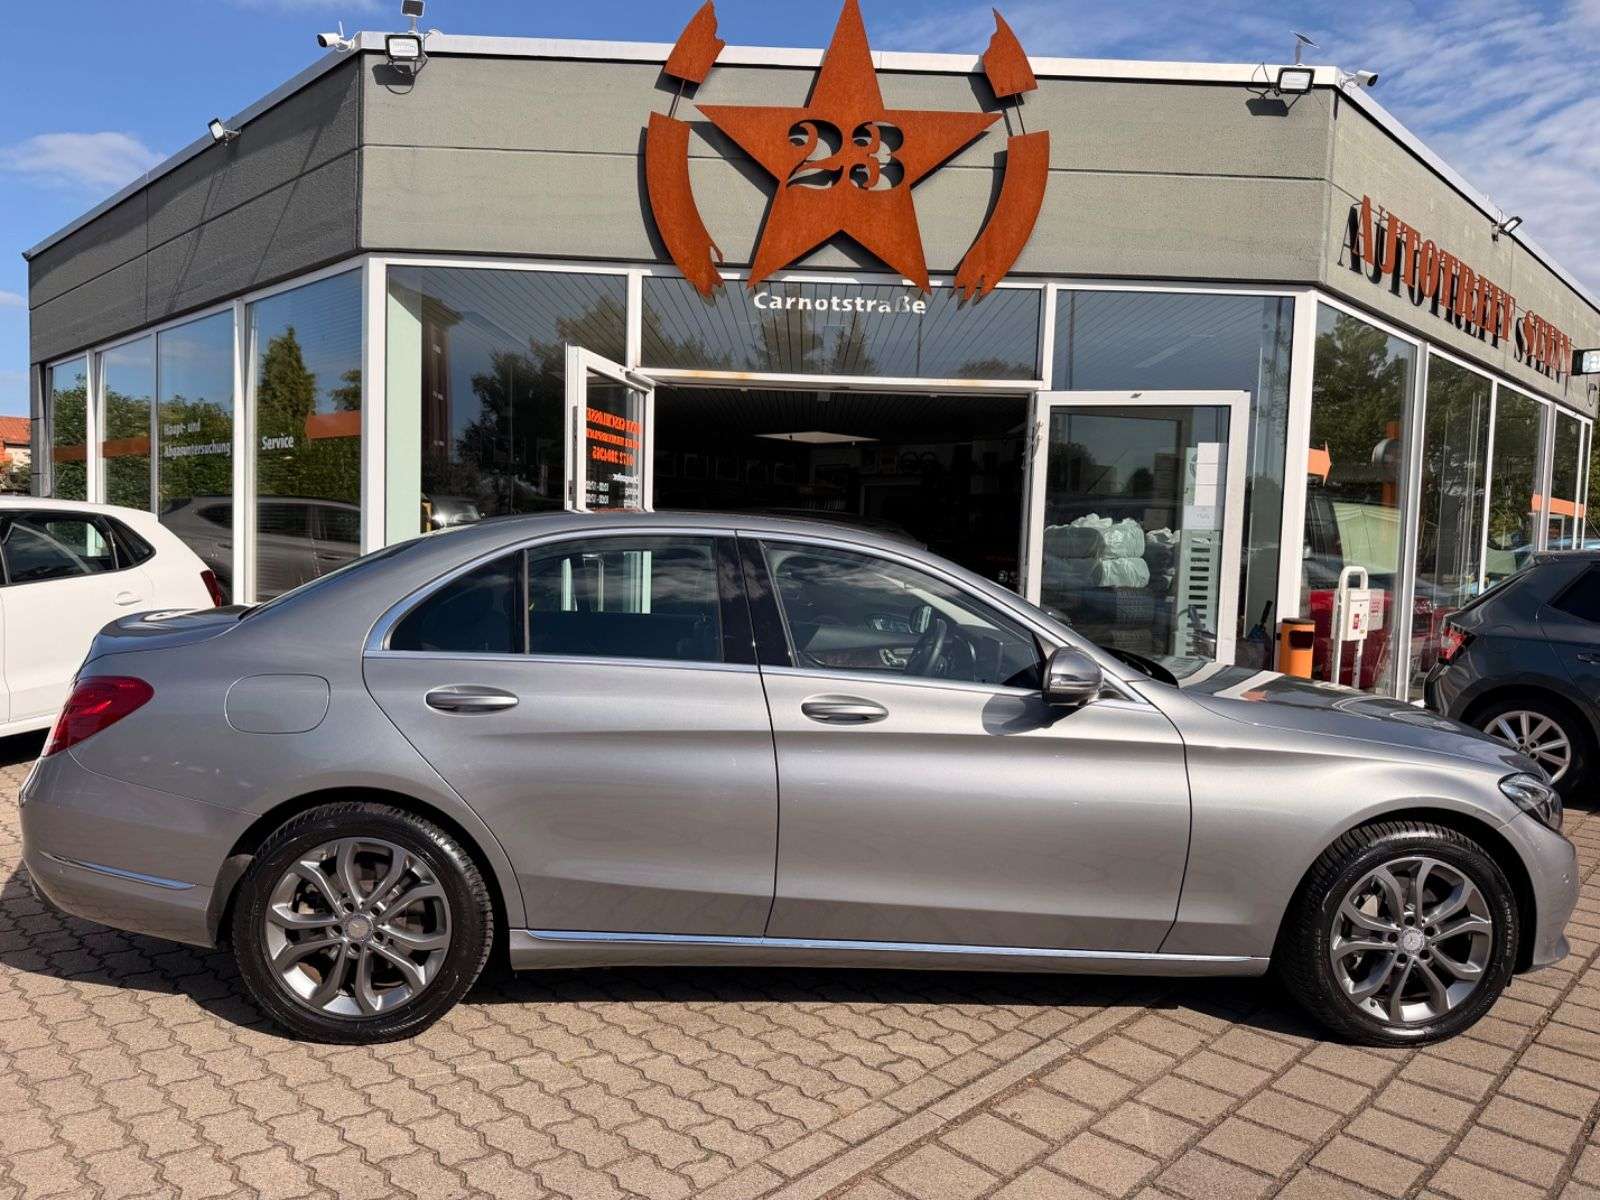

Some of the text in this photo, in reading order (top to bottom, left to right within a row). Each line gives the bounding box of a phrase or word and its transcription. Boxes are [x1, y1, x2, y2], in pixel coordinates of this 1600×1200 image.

[786, 119, 905, 192] 23
[1351, 194, 1516, 343] AUTOTREFF
[753, 292, 926, 314] Carnotstraße
[261, 433, 295, 450] Service
